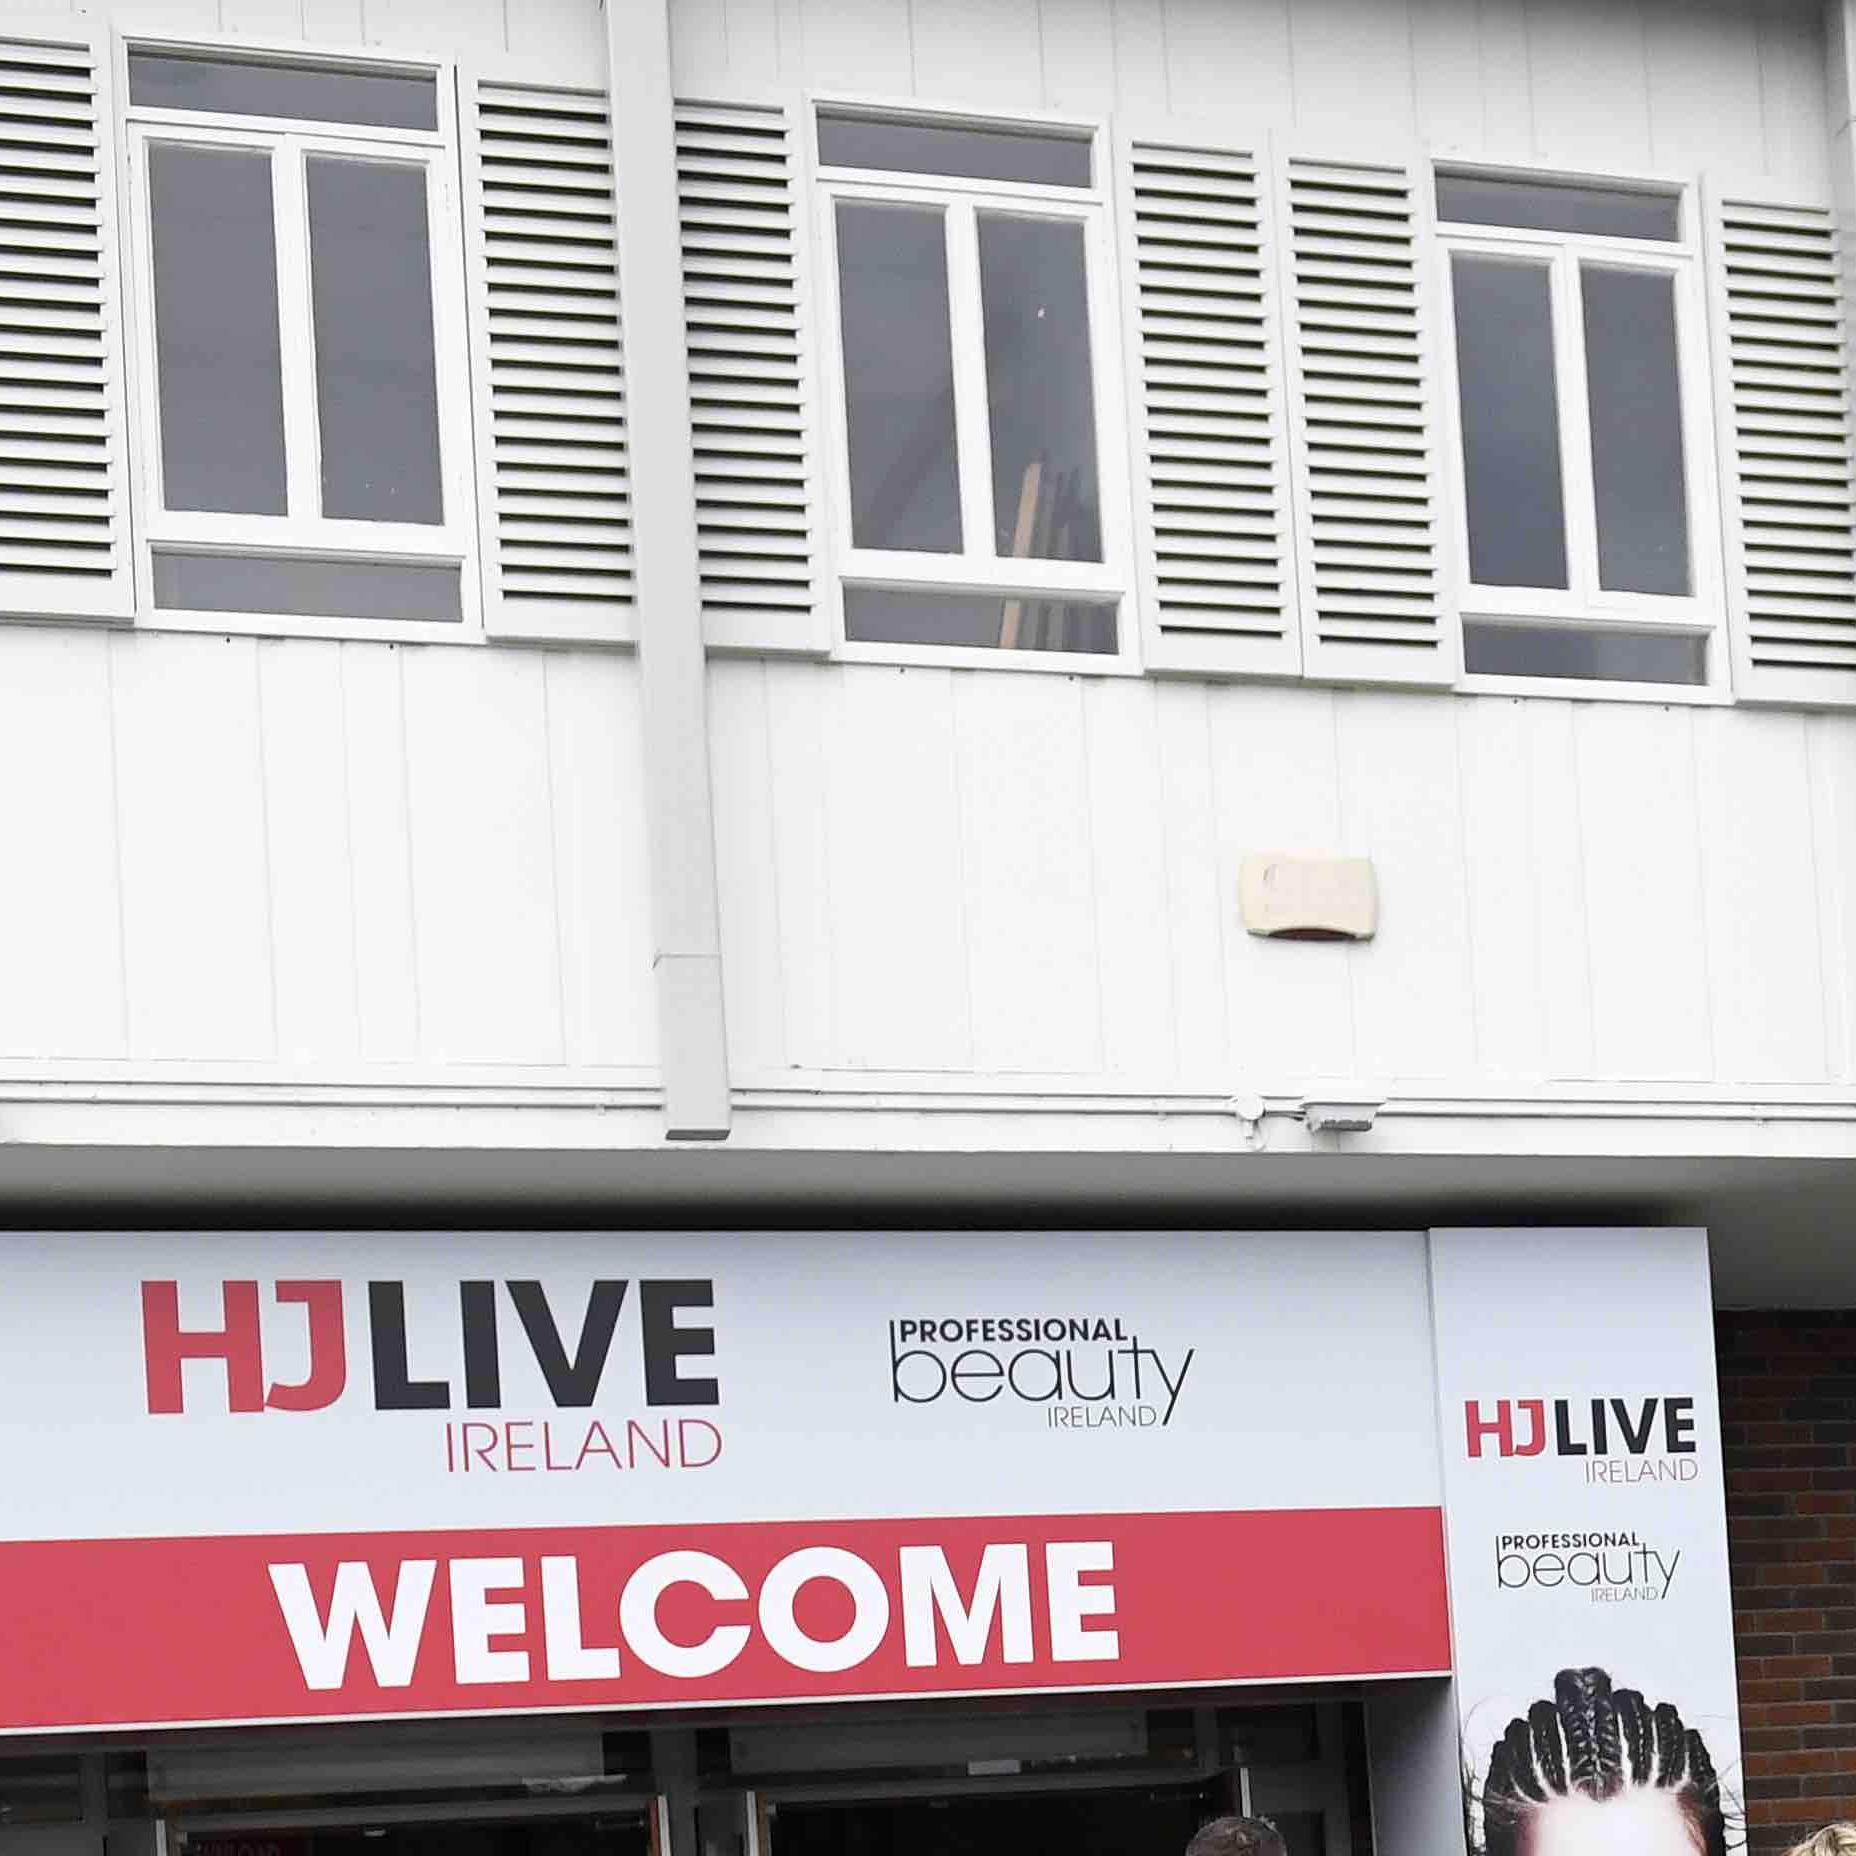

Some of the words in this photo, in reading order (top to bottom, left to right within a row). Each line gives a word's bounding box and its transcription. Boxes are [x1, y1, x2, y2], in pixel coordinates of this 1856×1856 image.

[900, 1318, 1128, 1343] PROFESSIONAL
[889, 1319, 1196, 1427] beauty
[1047, 1405, 1158, 1428] IRELAND
[447, 1418, 723, 1473] IRELAND
[1585, 1458, 1699, 1484] IRELAND
[1501, 1532, 1640, 1550] PROFESSIONAL
[1495, 1535, 1681, 1600] beauty
[1590, 1586, 1659, 1603] IRELAND
[268, 1541, 1121, 1691] WELCOME
